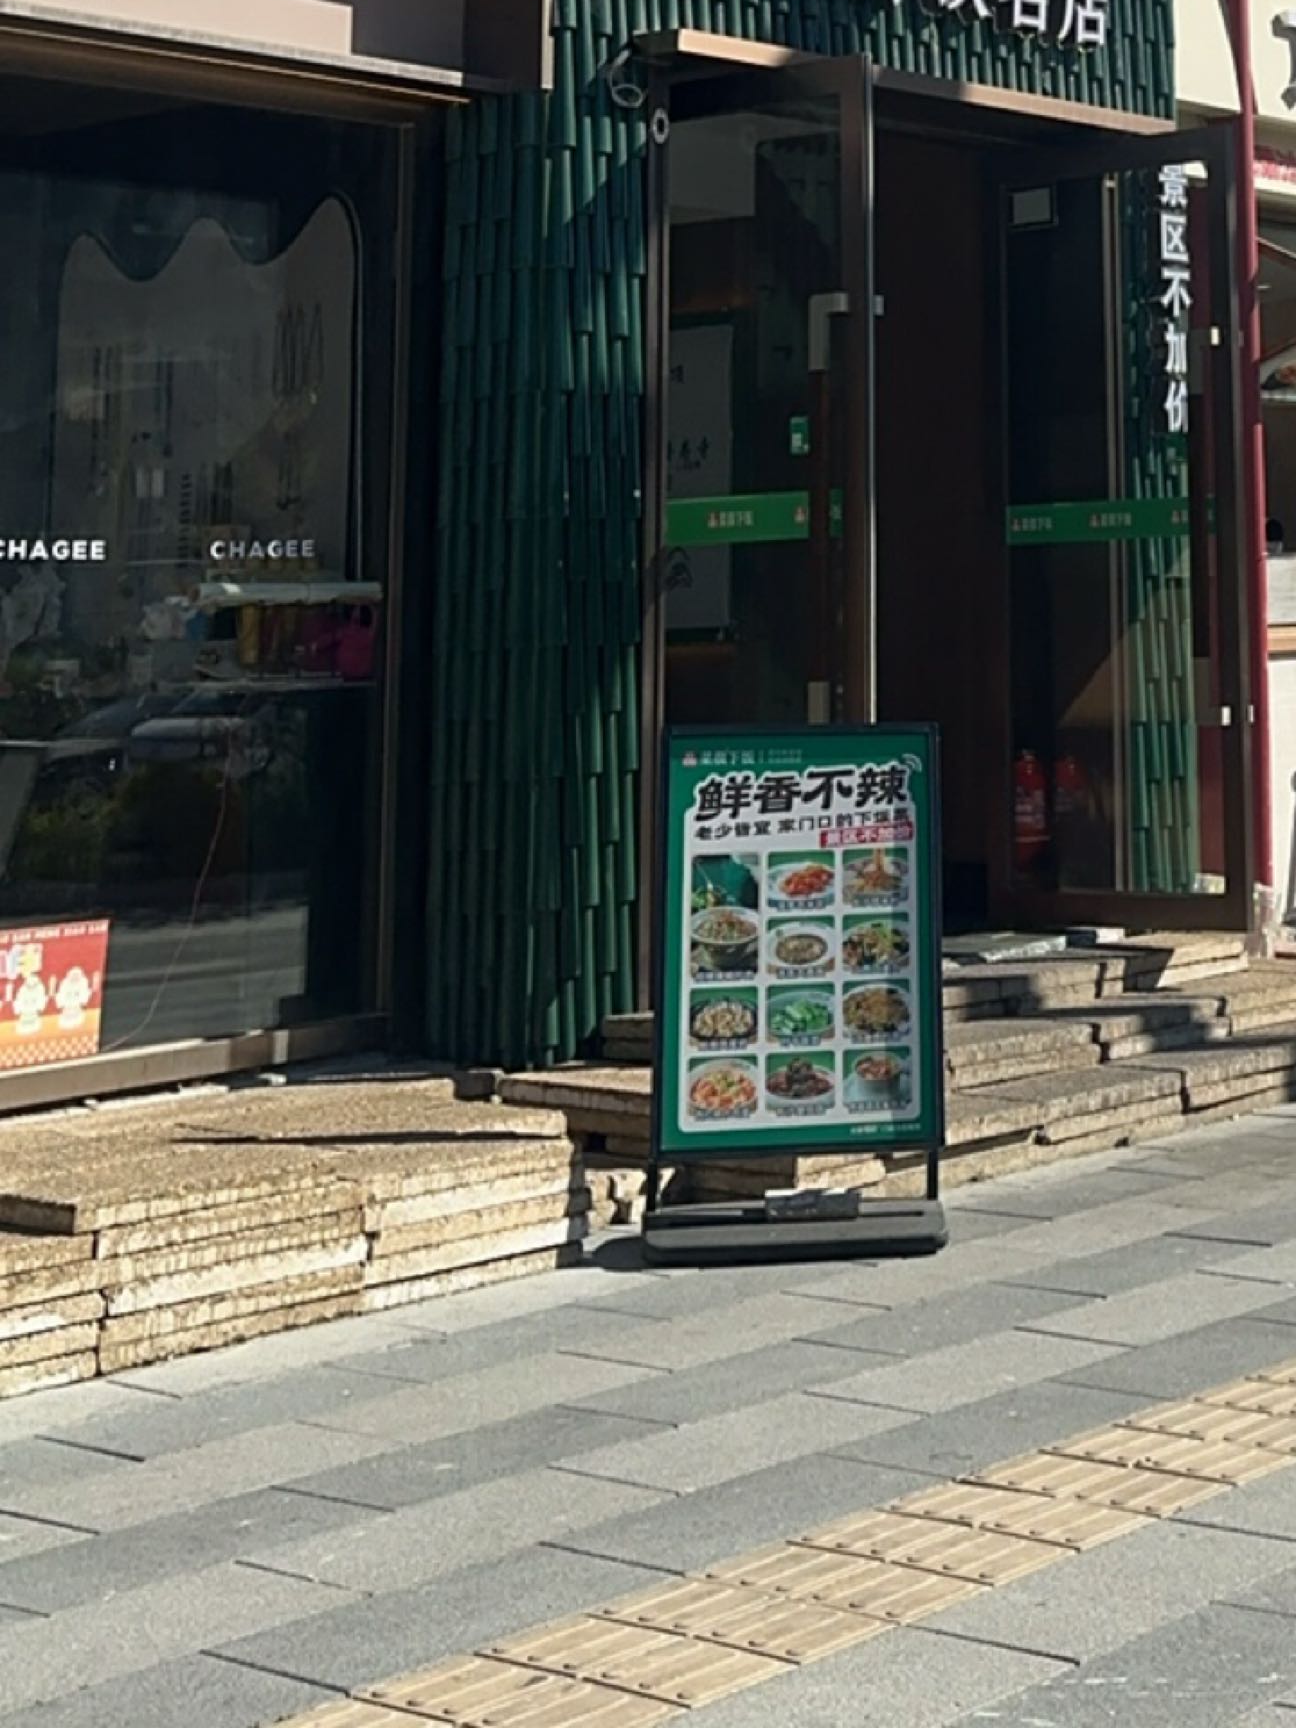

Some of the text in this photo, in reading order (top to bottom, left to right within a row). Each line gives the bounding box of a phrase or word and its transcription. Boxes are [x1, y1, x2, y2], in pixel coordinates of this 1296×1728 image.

[209, 539, 316, 560] CHAGEE
[694, 765, 908, 822] 鲜香不辣
